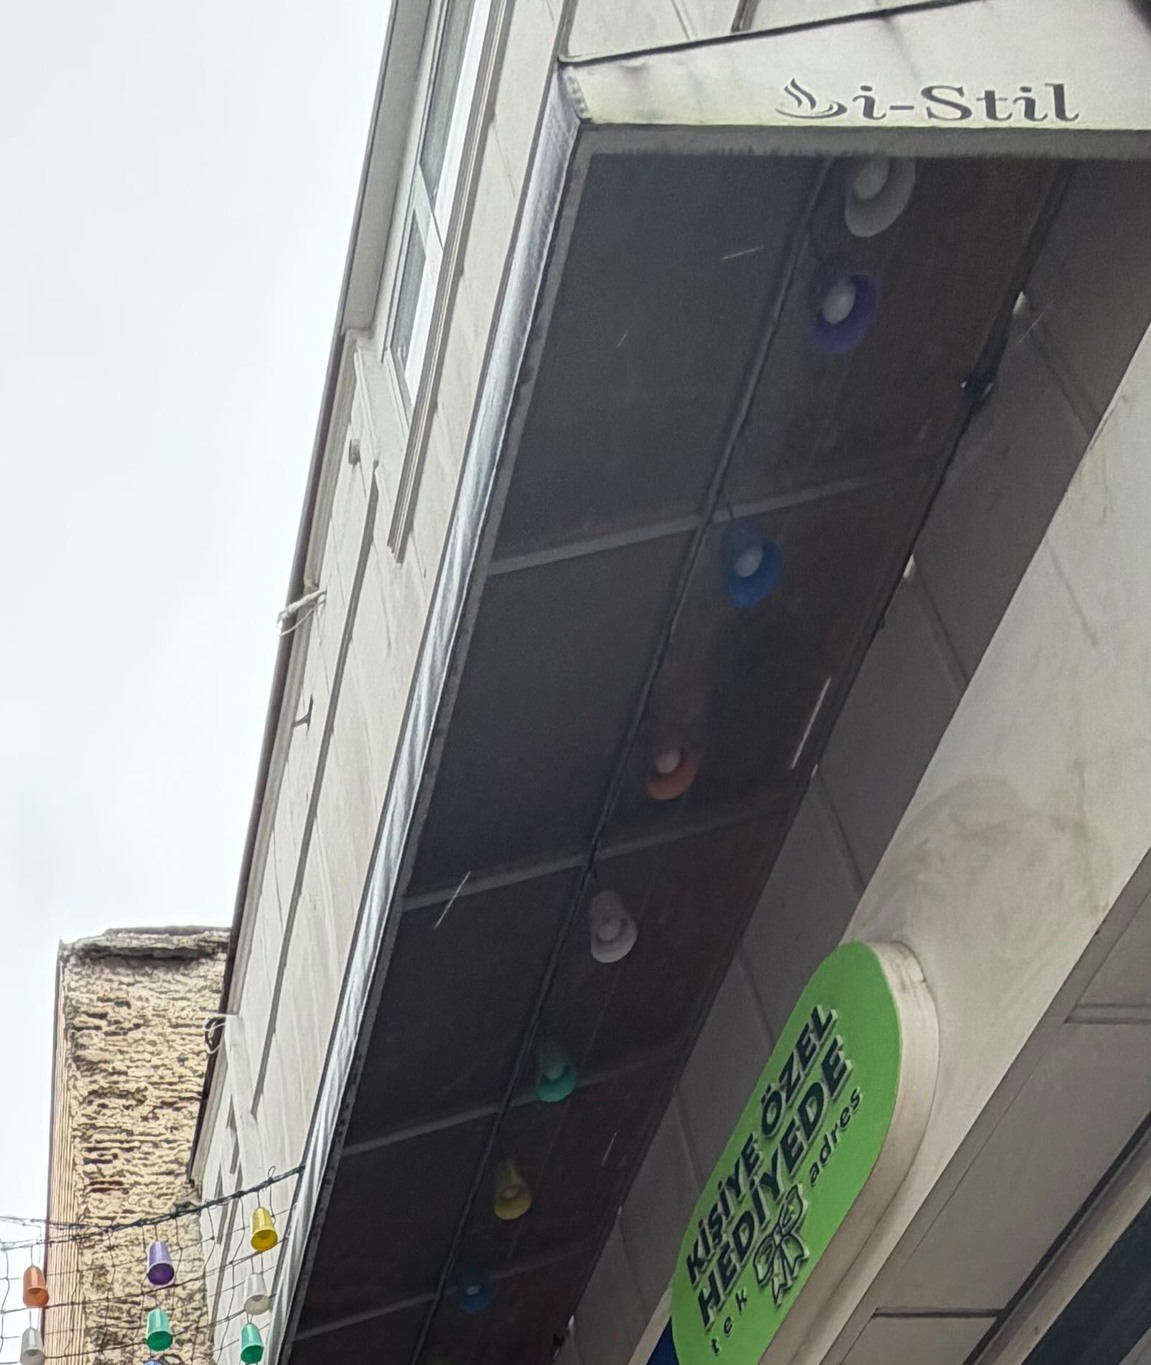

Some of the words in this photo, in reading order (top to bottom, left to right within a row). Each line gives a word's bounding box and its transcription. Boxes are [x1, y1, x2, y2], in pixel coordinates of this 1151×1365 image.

[686, 1132, 762, 1287] KİŞİYE
[760, 1004, 838, 1139] ÖZEL
[698, 1035, 852, 1331] HEDİYEDE
[711, 1288, 748, 1356] tek
[809, 1086, 863, 1186] adres
